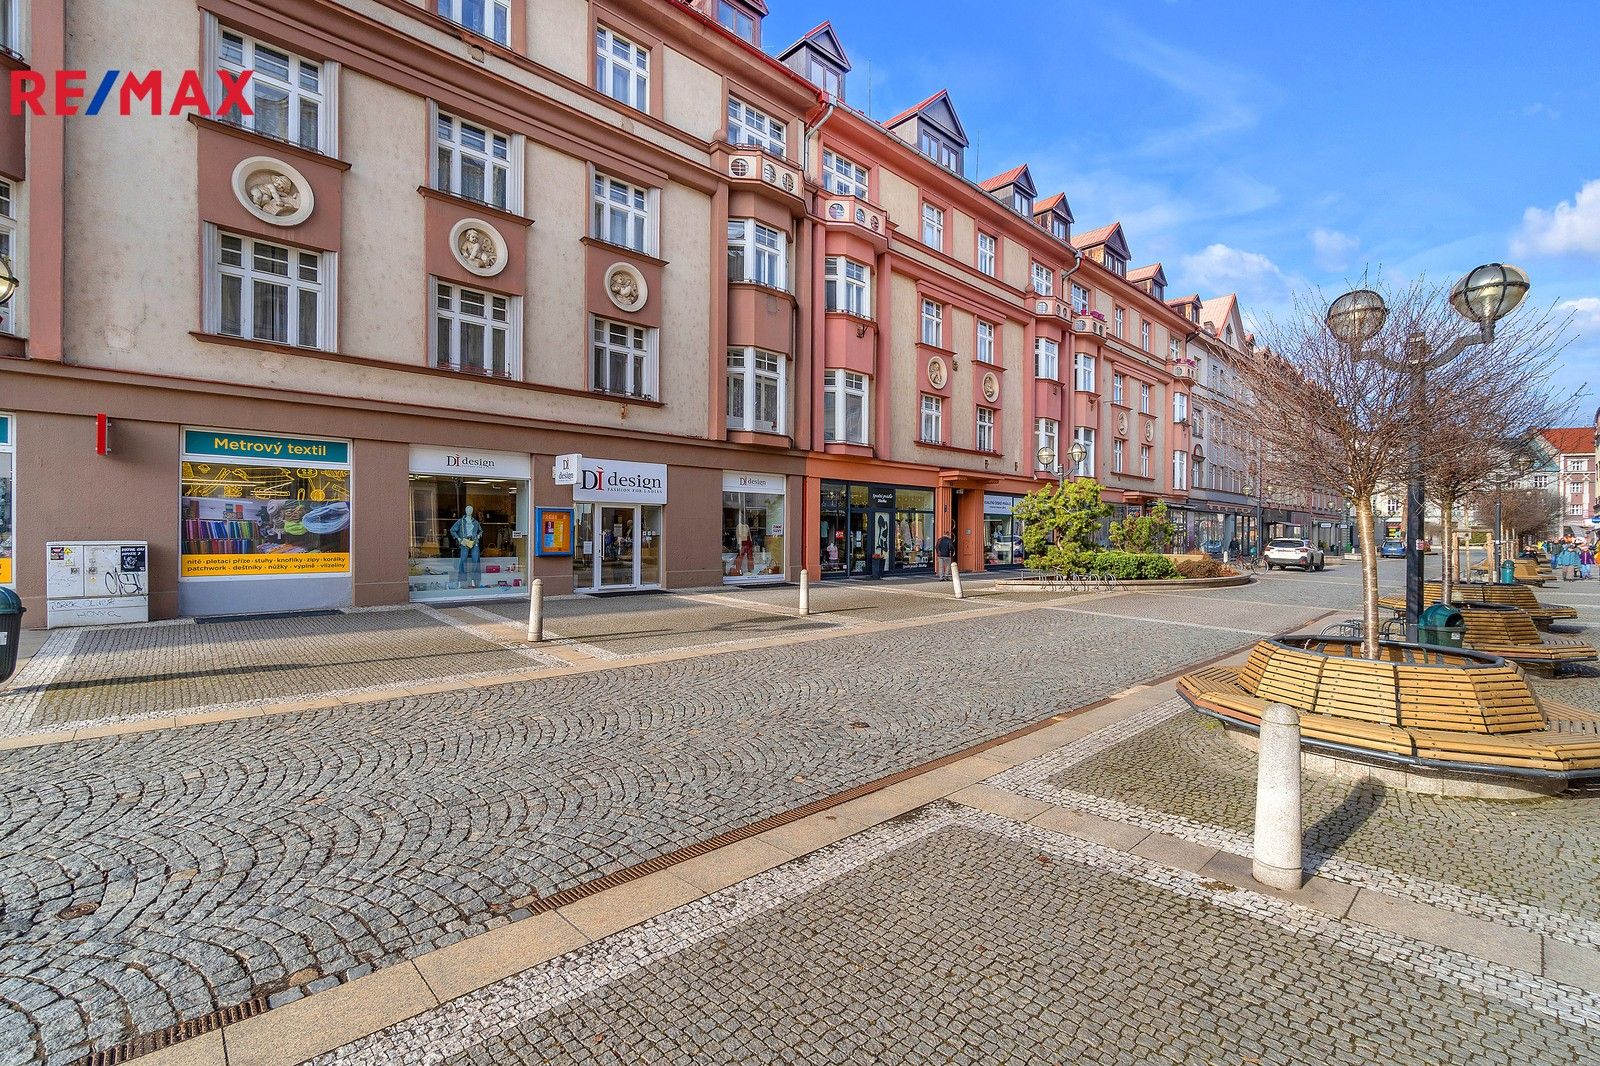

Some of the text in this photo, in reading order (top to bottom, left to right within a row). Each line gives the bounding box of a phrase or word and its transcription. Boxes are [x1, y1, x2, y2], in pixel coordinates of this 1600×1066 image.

[214, 437, 327, 456] Metrový textil
[461, 456, 495, 468] design
[607, 471, 663, 490] design
[747, 477, 767, 486] design
